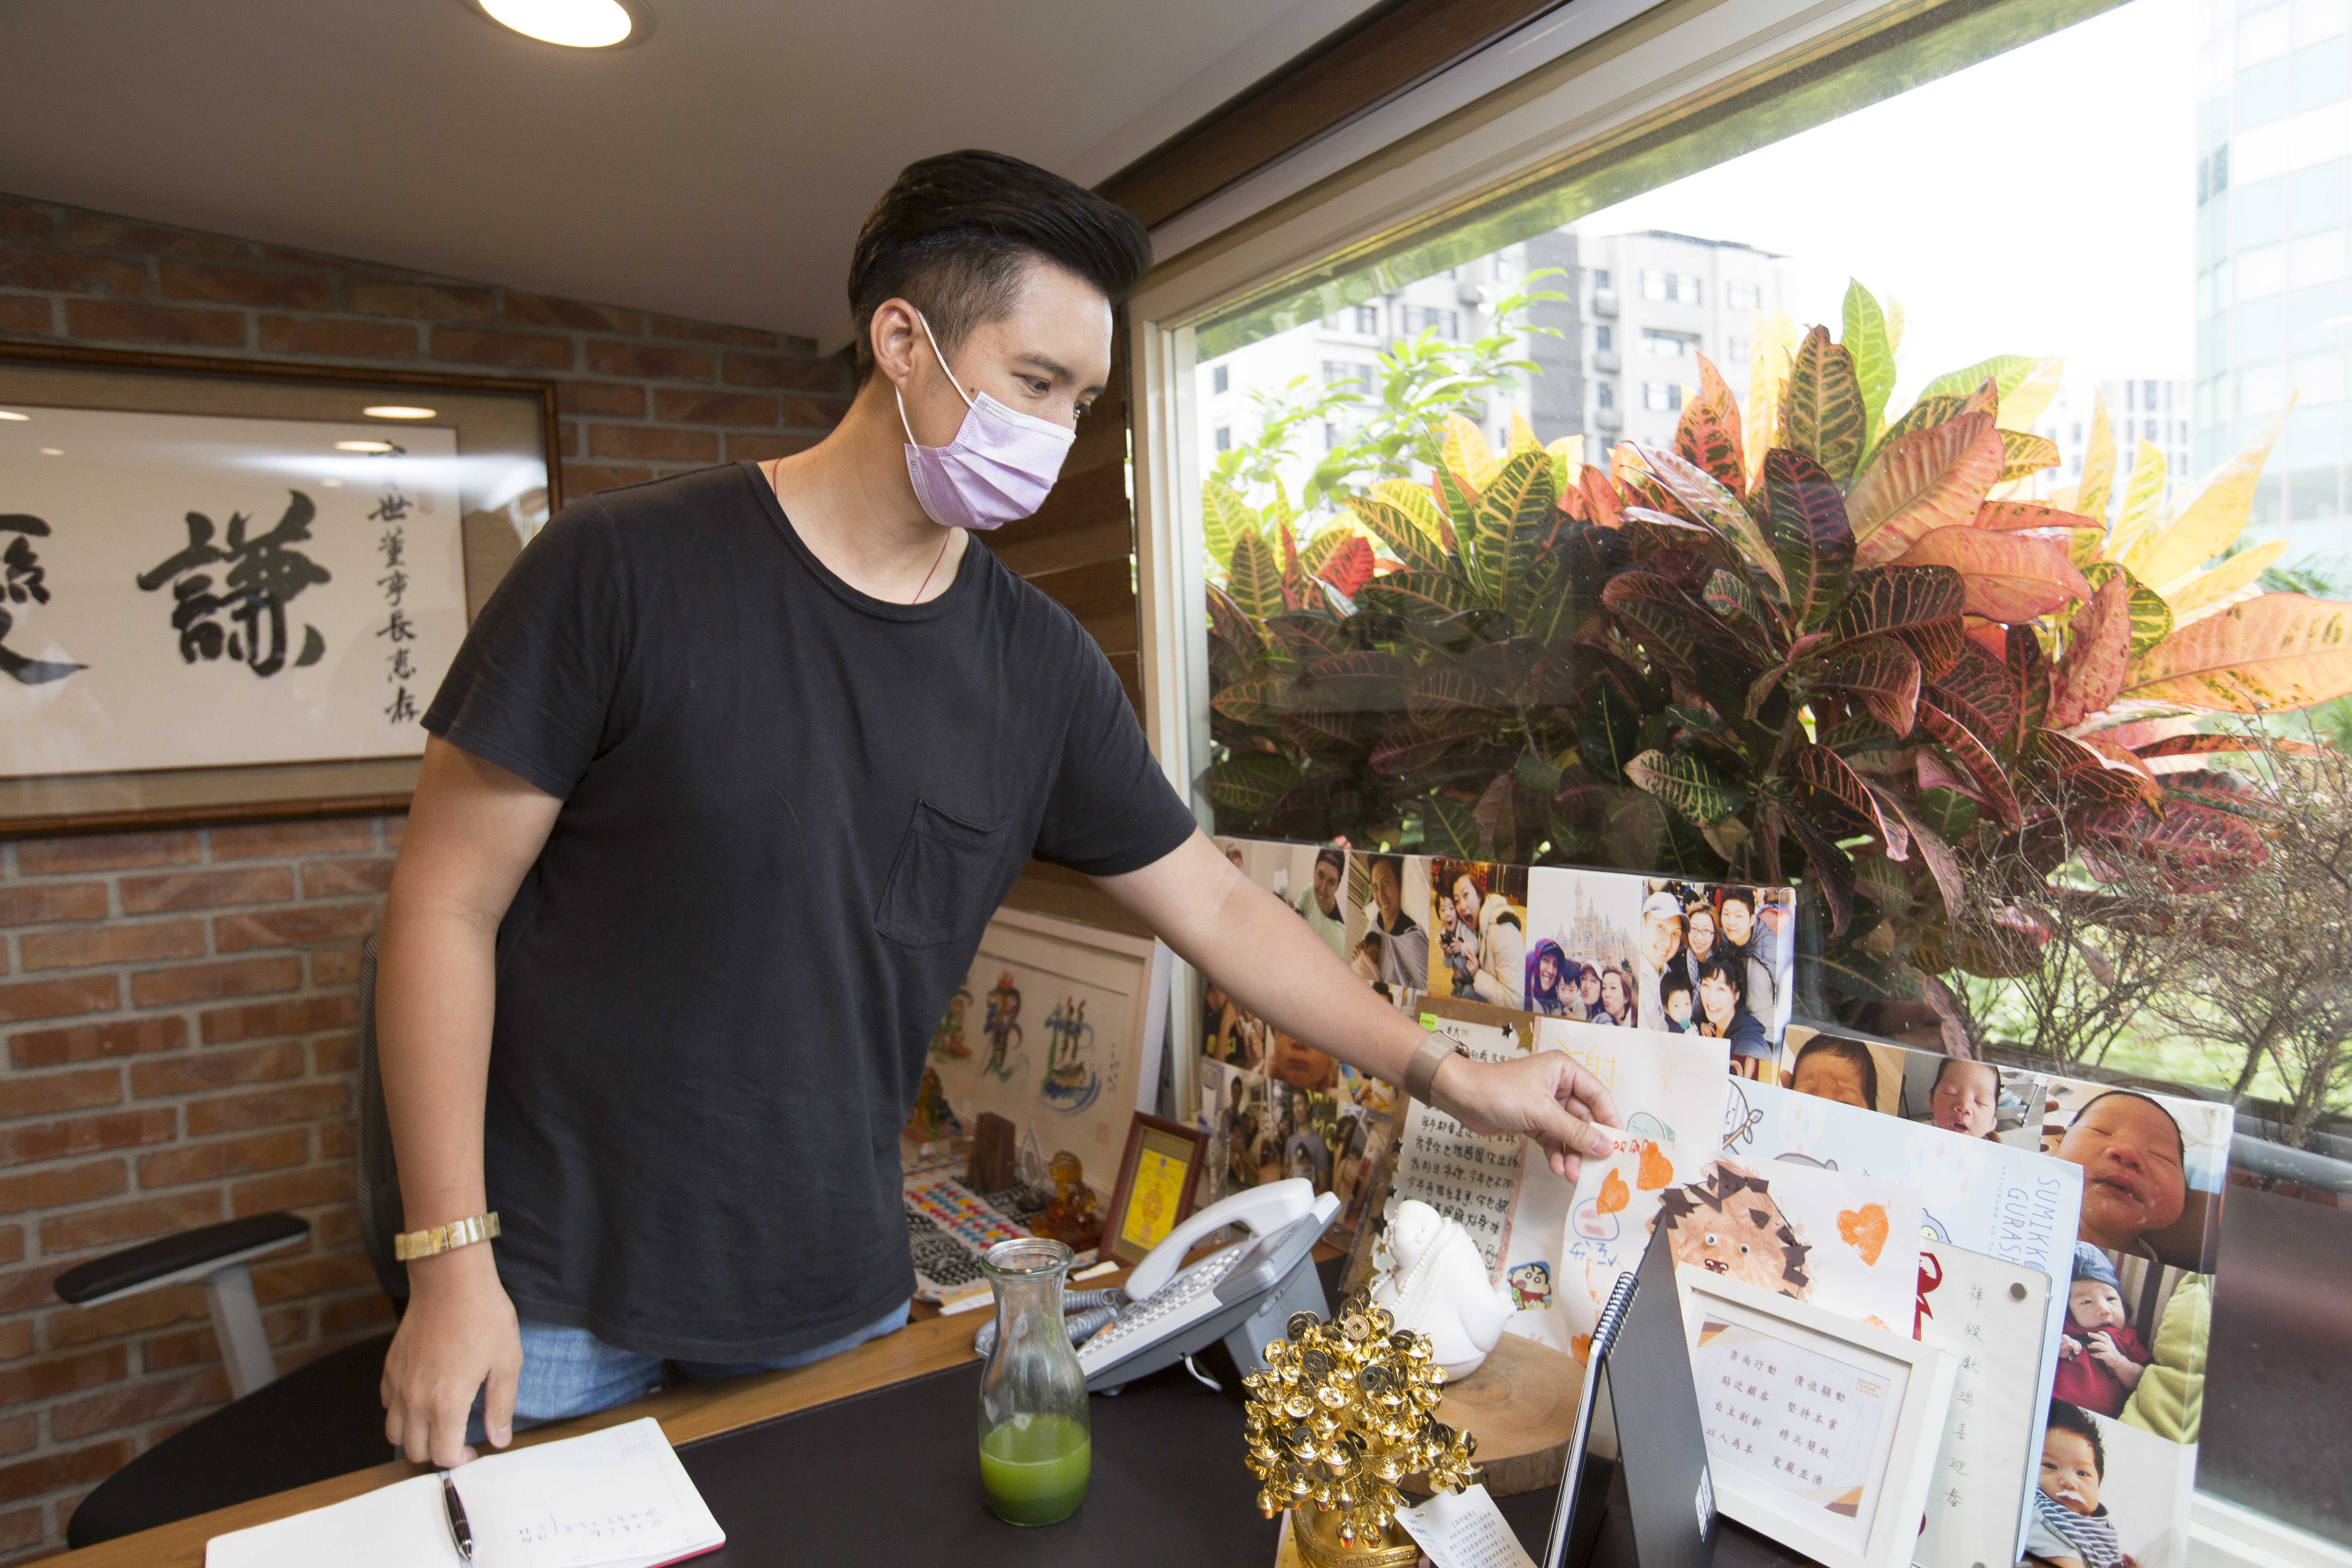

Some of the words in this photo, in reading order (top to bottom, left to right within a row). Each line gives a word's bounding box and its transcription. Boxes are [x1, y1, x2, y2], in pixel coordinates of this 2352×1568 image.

[136, 489, 332, 679] 謙
[1993, 1166, 2007, 1218] shirokuma
[1990, 1225, 1996, 1235] no
[1721, 1375, 1769, 1402] 貼近顧客
[1787, 1401, 1838, 1430] 堅持本業
[1730, 1349, 1777, 1375] 崇尚行動
[1794, 1374, 1846, 1403] 價值驅動
[1857, 1382, 1876, 1392] FLOOR
[1858, 1377, 1881, 1390] SECOND
[1715, 1401, 1762, 1429] 自主創新
[1778, 1428, 1830, 1459] 精兵簡政
[1707, 1428, 1754, 1455] 以人為本
[1771, 1455, 1823, 1488] 寬嚴並濟
